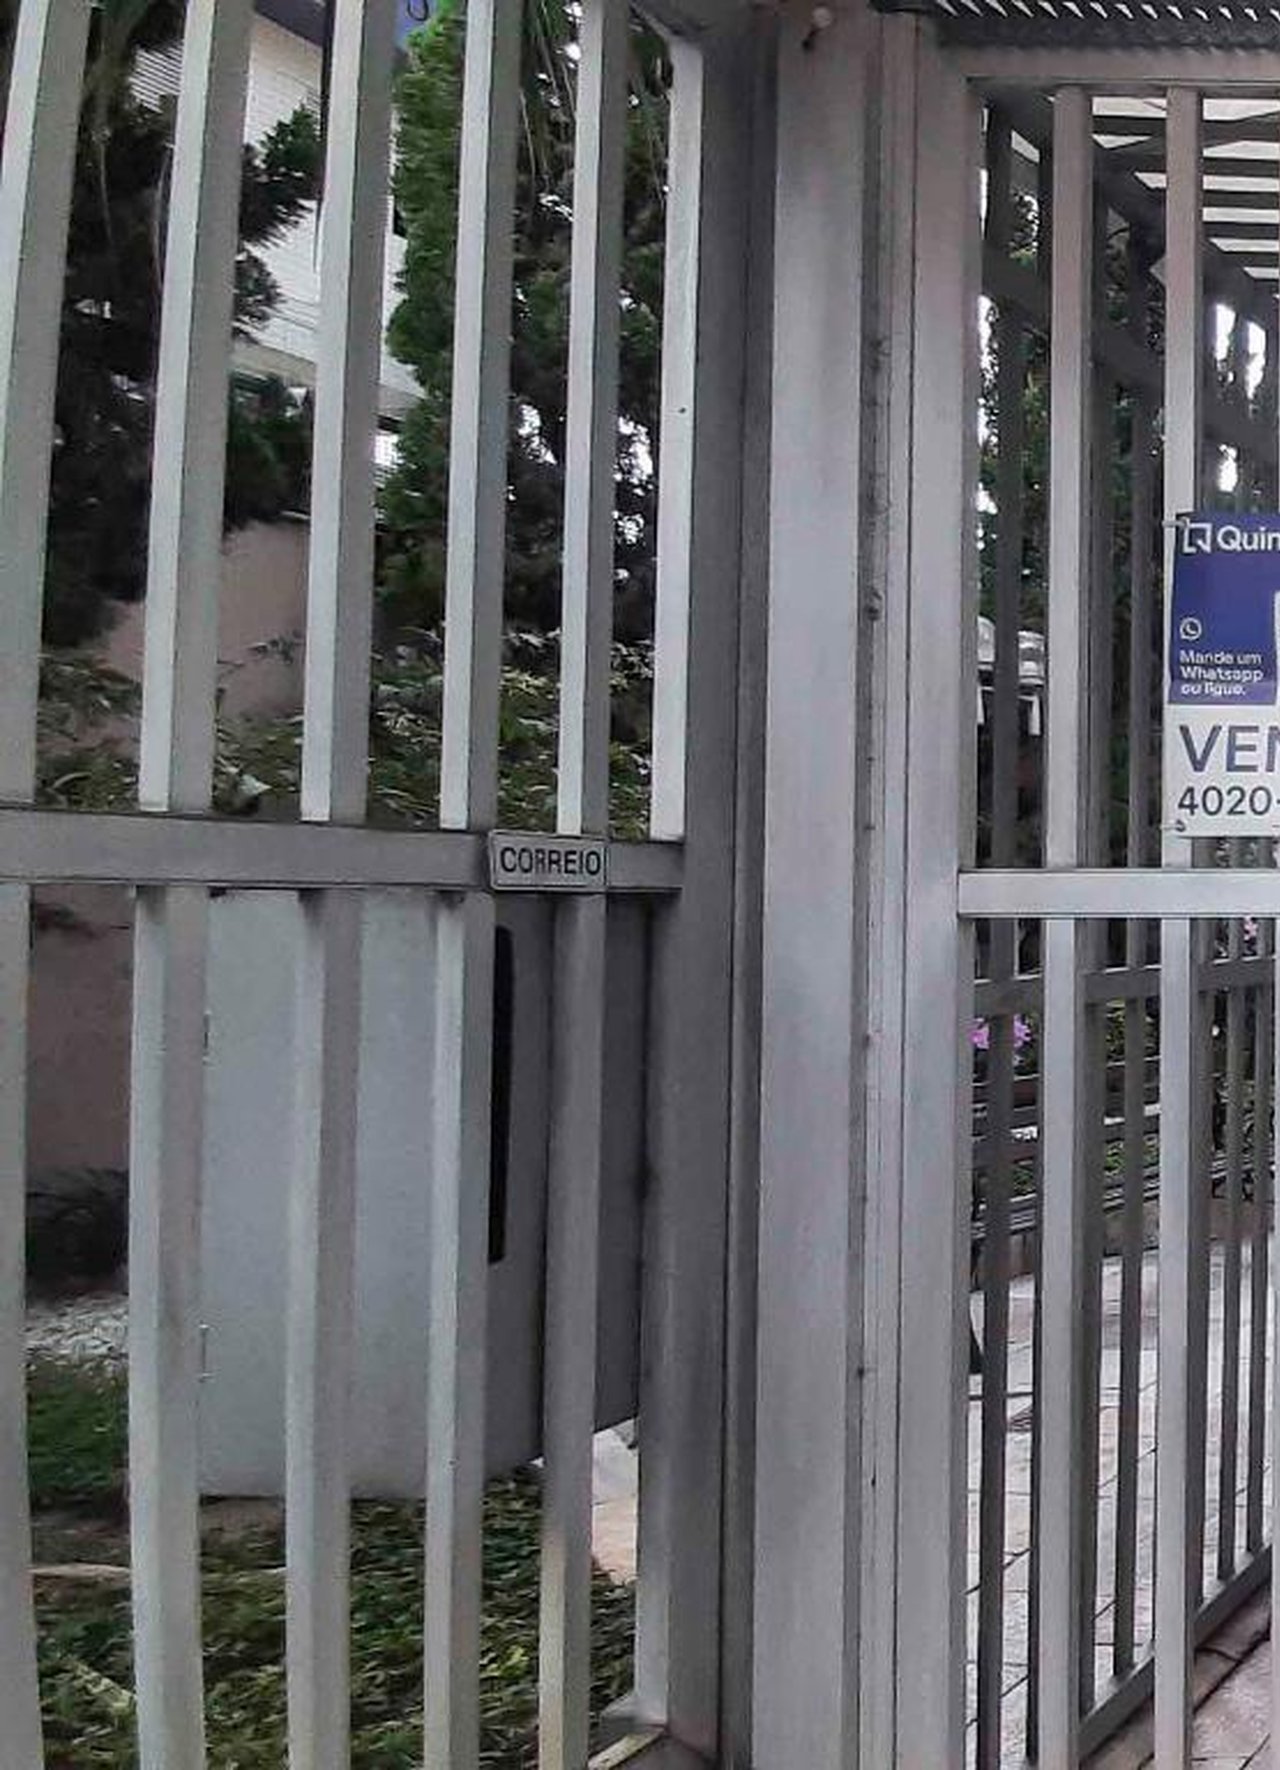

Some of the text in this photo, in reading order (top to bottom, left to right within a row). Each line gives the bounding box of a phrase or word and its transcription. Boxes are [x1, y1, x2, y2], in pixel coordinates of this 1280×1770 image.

[1180, 650, 1261, 664] Mande um
[1181, 666, 1263, 681] Whatsapp
[501, 847, 601, 875] CORREIO
